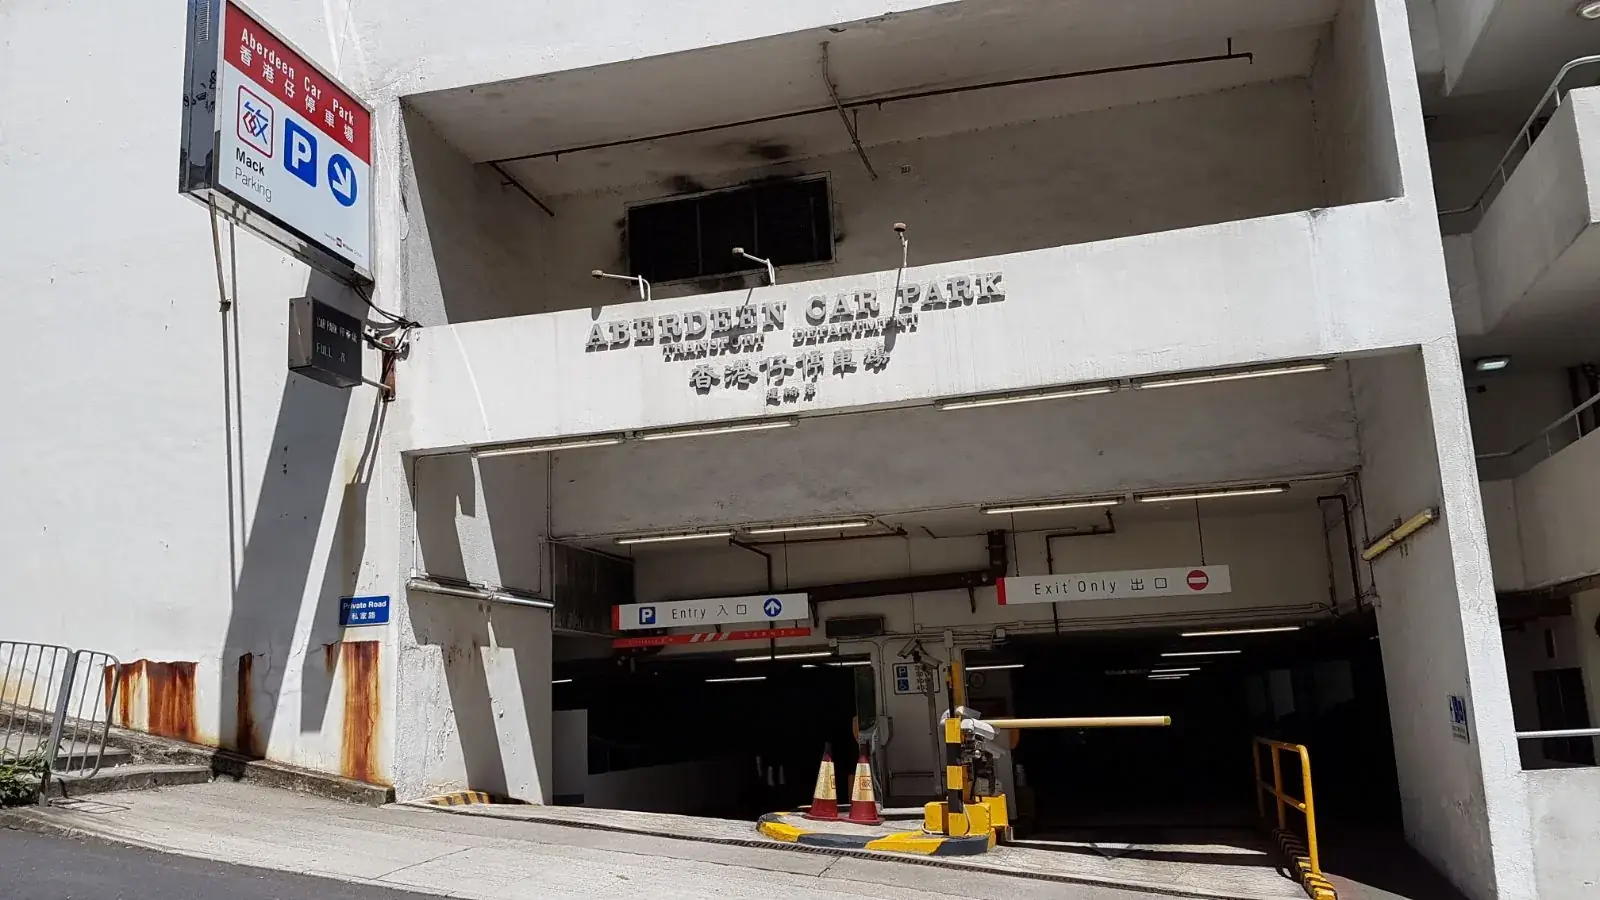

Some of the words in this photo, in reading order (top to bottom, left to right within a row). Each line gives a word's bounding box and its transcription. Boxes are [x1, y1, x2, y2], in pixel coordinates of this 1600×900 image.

[241, 27, 295, 80] Aberdeen
[304, 75, 322, 101] Car
[332, 98, 354, 126] Park
[240, 46, 354, 145] 香港仔停車場
[236, 147, 265, 177] Mack
[292, 132, 313, 170] P
[235, 168, 272, 203] Parking
[586, 299, 788, 348] ABERDEEN
[806, 286, 880, 323] CAR
[897, 271, 1006, 313] PARK
[663, 333, 765, 359] TRANSPORT
[792, 313, 919, 343] DEPARTMENT
[316, 342, 333, 359] FULL
[690, 342, 890, 390] 香港仔停車場
[1035, 582, 1068, 597] Exit
[1078, 579, 1117, 595] Only
[1130, 577, 1168, 593] 出口
[343, 602, 367, 610] Private
[368, 600, 387, 608] Road
[351, 611, 376, 620] 私家路
[642, 608, 654, 623] P
[672, 607, 707, 621] Entry
[715, 604, 747, 617] 入口
